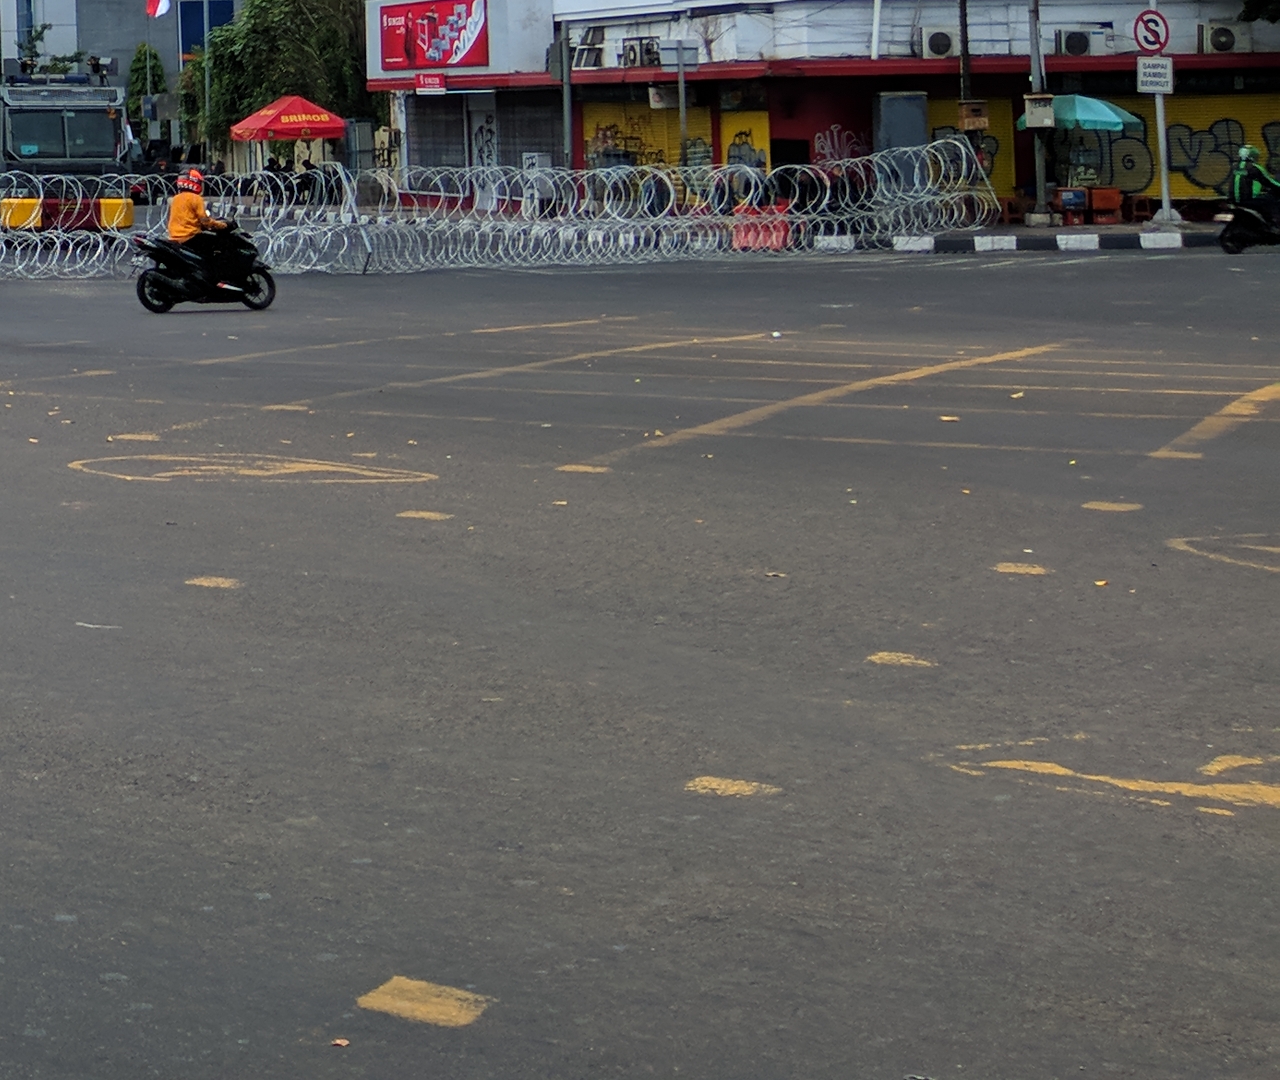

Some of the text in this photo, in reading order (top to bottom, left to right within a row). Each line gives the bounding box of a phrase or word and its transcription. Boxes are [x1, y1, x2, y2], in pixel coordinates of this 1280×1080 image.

[1142, 62, 1168, 70] SAMPAI
[1142, 71, 1168, 79] RAMBU
[1140, 80, 1169, 88] BERIKUT
[280, 113, 330, 124] BRIMOB
